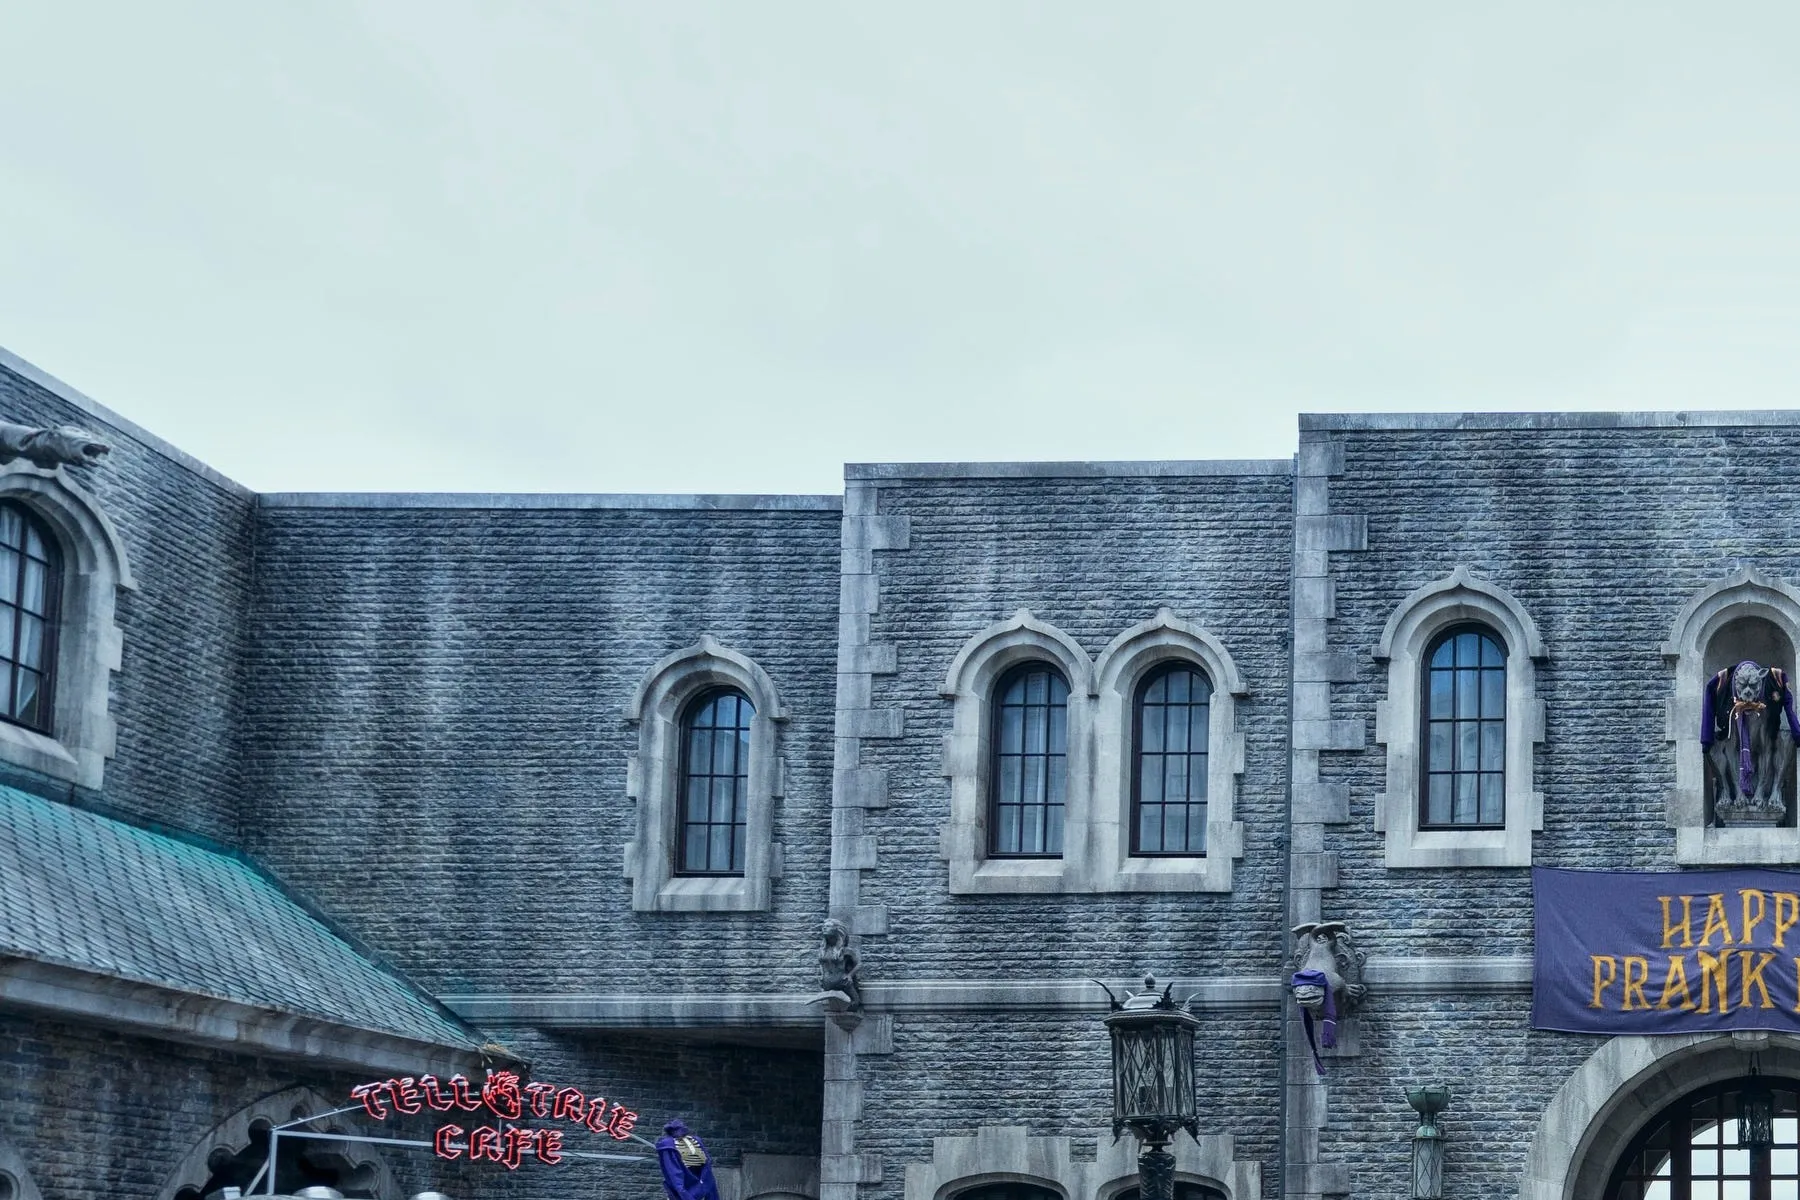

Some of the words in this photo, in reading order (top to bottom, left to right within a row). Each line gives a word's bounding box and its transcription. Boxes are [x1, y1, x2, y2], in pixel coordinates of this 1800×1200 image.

[1588, 948, 1776, 1014] PRANK
[351, 1073, 482, 1120] TELL
[525, 1081, 638, 1141] TALE
[435, 1124, 564, 1170] CAFE
